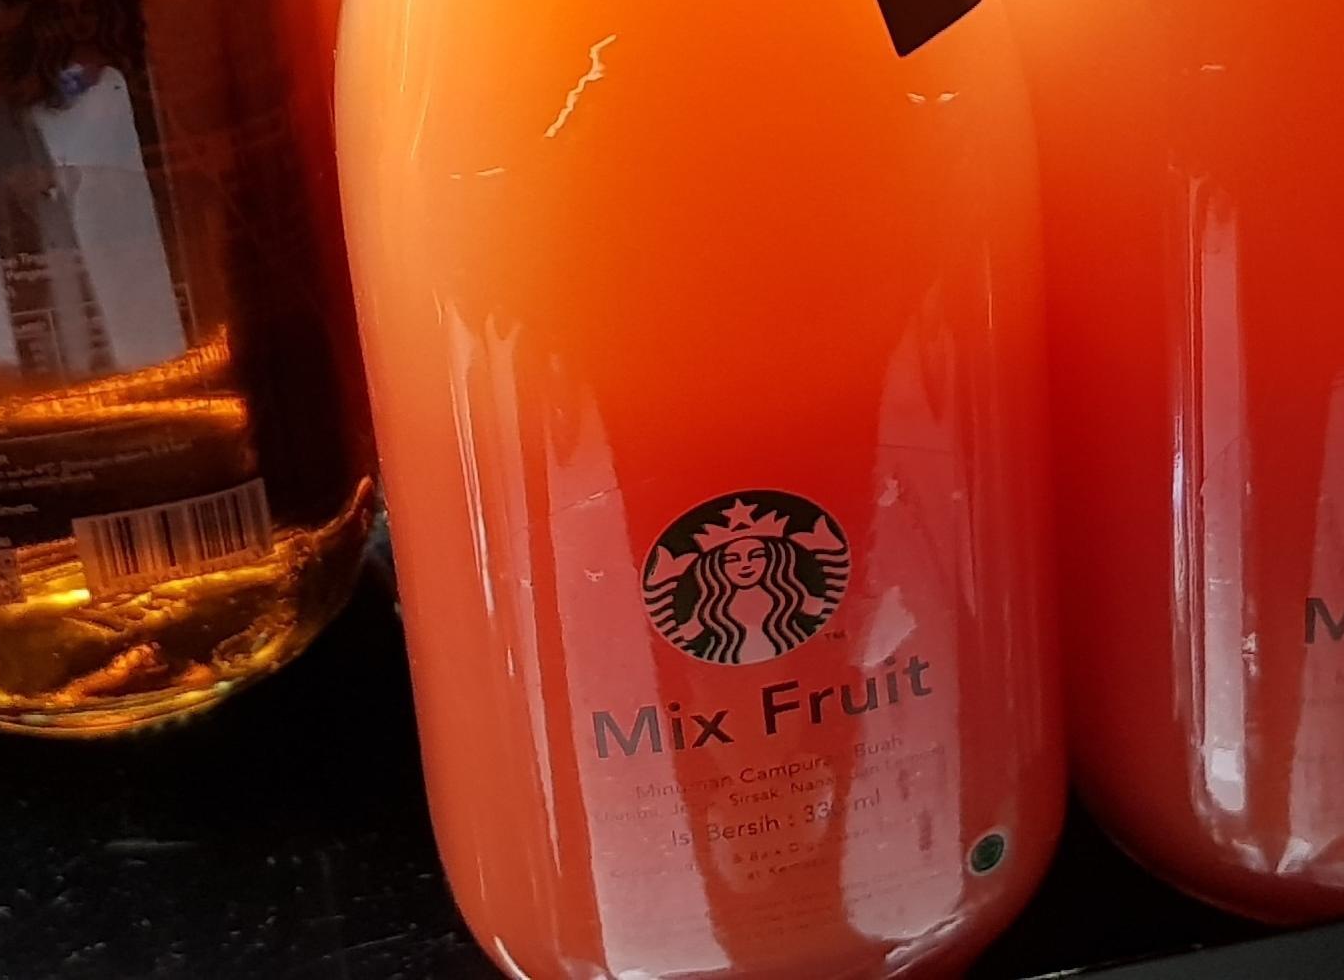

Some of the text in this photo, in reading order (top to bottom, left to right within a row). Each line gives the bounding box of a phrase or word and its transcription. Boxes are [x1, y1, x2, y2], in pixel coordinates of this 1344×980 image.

[592, 655, 933, 759] Mix Fruit
[854, 735, 903, 758] Buah
[706, 817, 781, 843] Bersih
[854, 788, 882, 814] ml
